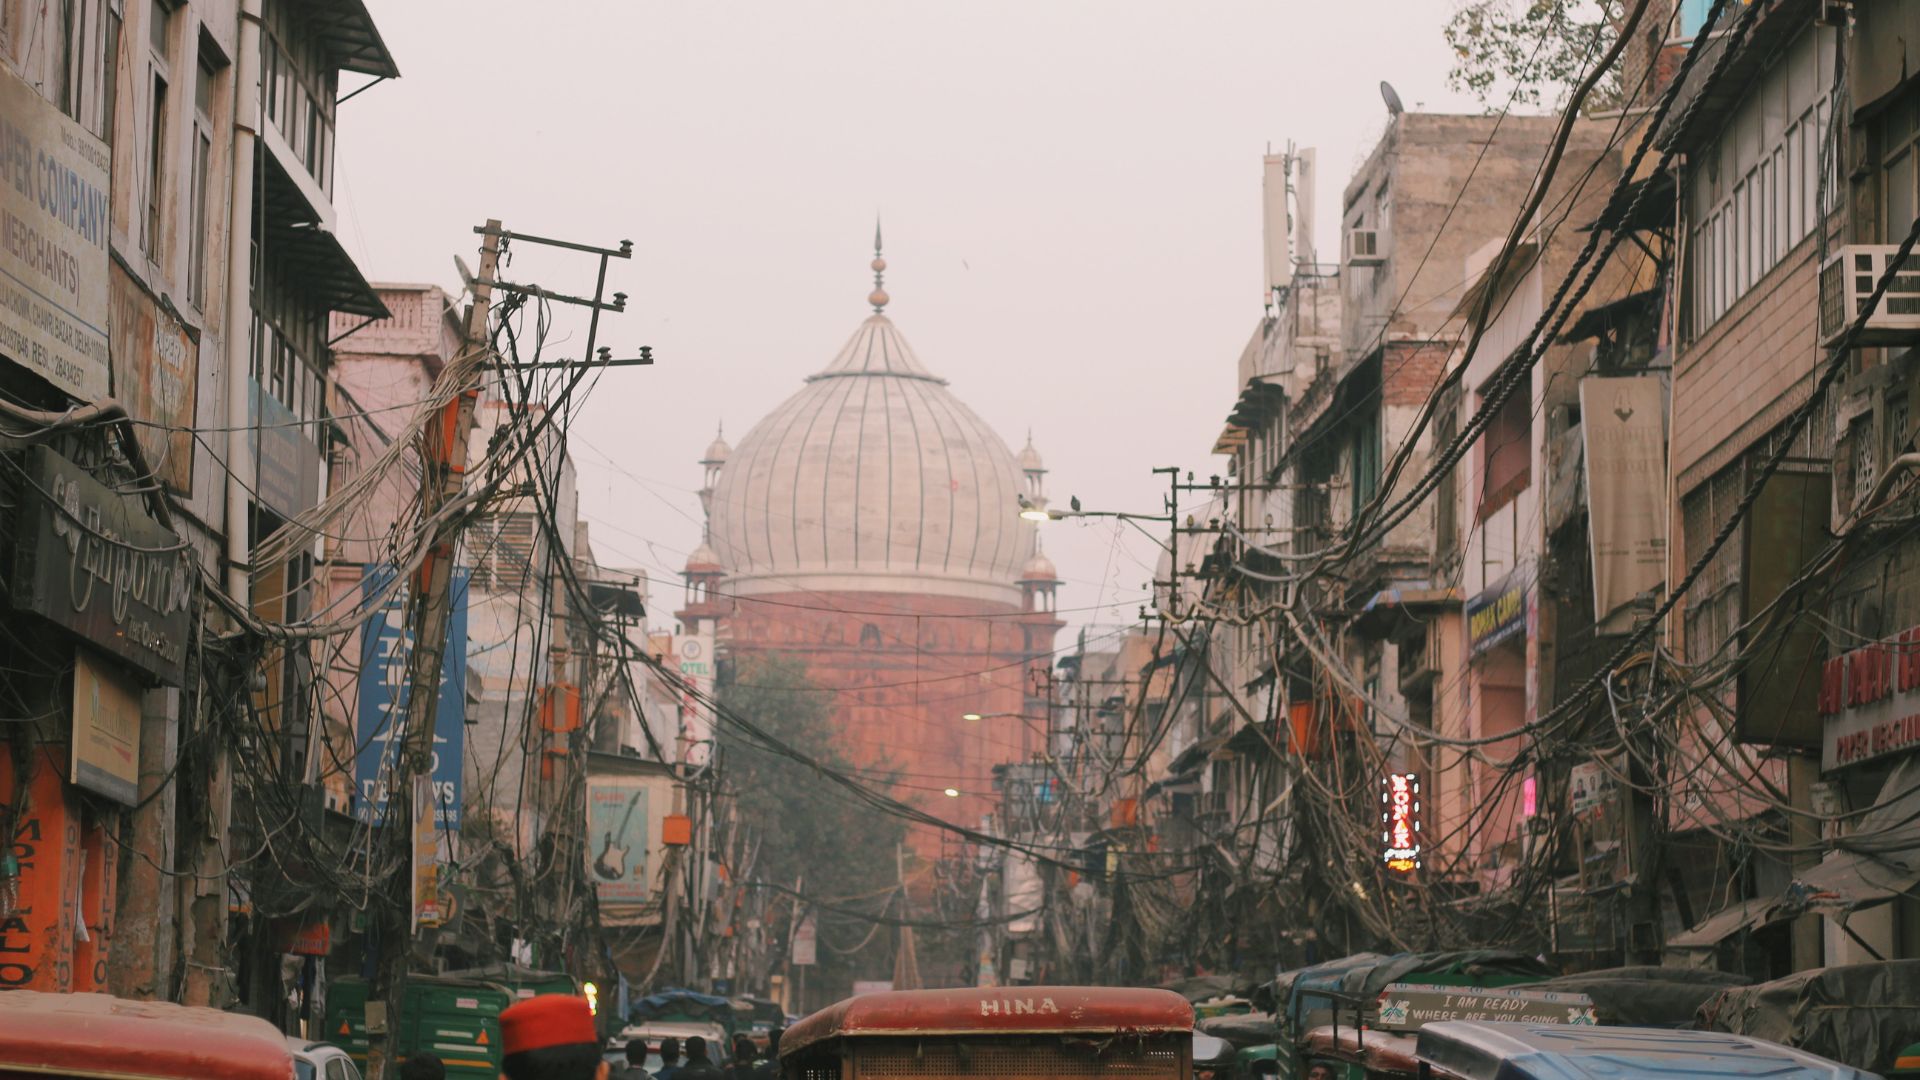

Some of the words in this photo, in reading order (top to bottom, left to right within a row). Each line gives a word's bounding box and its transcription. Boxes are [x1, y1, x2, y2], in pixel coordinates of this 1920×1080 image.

[38, 148, 108, 250] COMPANY
[679, 662, 708, 675] OTEL
[981, 998, 1058, 1016] HINA
[1443, 995, 1453, 1008] I
[1457, 996, 1478, 1009] AM
[1483, 998, 1529, 1011] READY
[1412, 1009, 1458, 1021] WHERE
[1465, 1011, 1487, 1021] ARE
[1494, 1013, 1516, 1022] YOU
[1520, 1014, 1560, 1024] GOING
